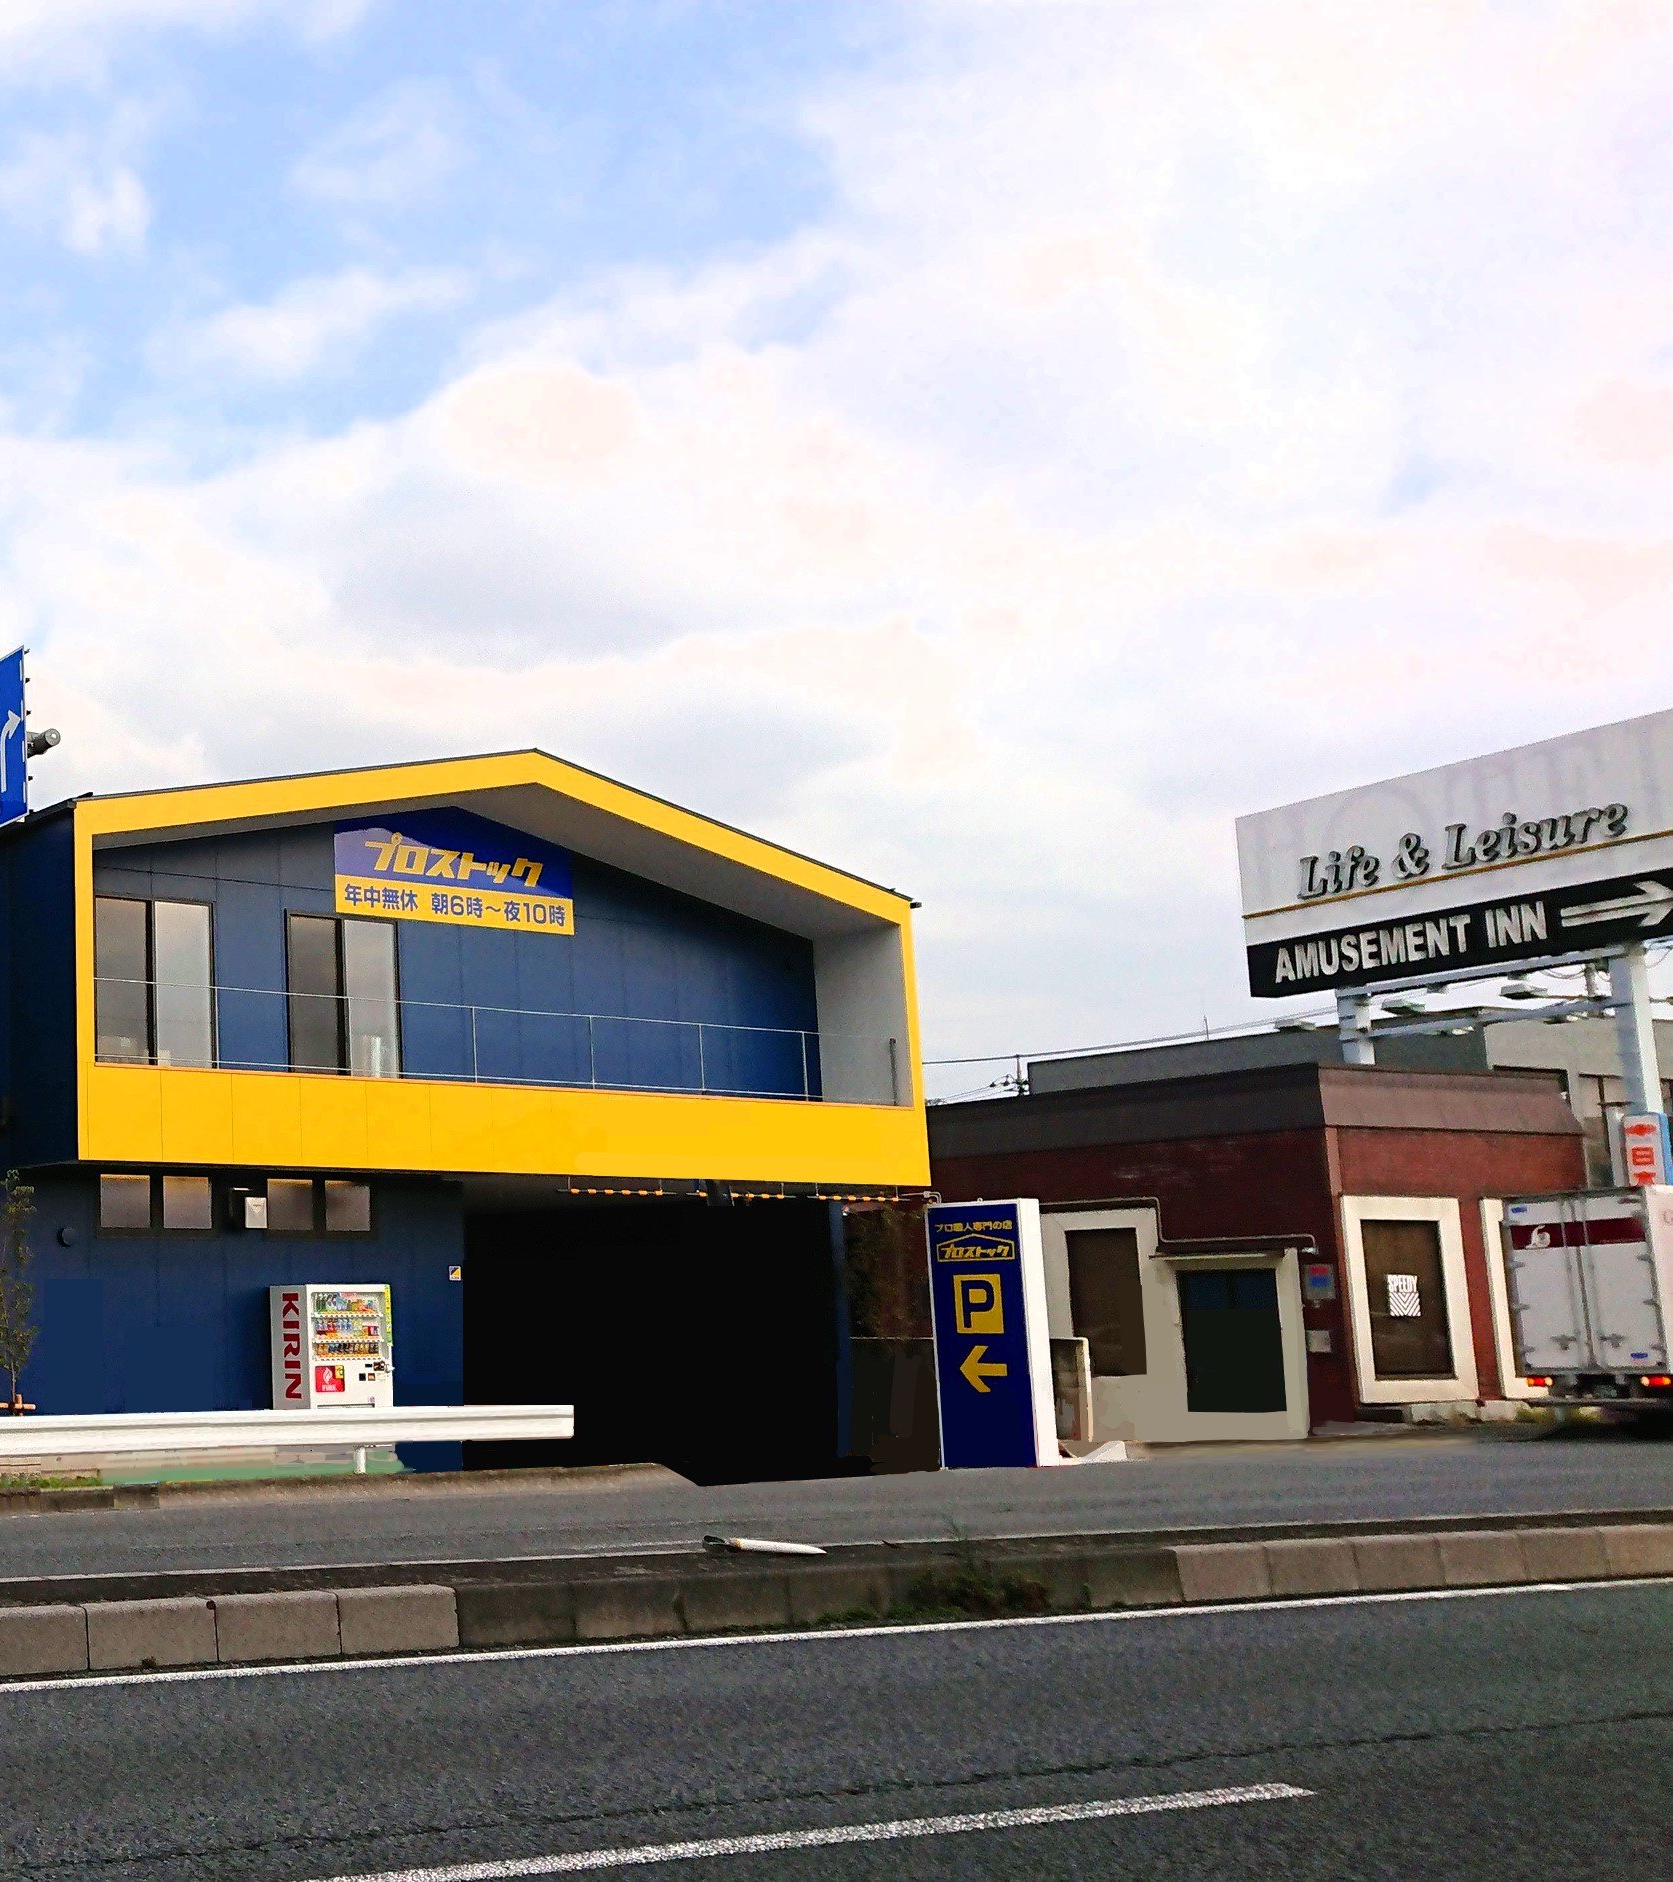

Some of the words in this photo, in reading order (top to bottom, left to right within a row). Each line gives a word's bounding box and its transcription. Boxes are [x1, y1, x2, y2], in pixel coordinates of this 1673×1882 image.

[365, 832, 543, 888] プロストック
[1297, 845, 1380, 900] Life
[1392, 832, 1430, 879] &
[1442, 802, 1629, 870] Leisure
[344, 884, 418, 912] 年中無休
[1275, 914, 1471, 984] AMUSEMENT
[1485, 900, 1549, 948] INN
[941, 1243, 1010, 1259] プロストック
[961, 1280, 995, 1328] P
[282, 1293, 302, 1399] KIRIN
